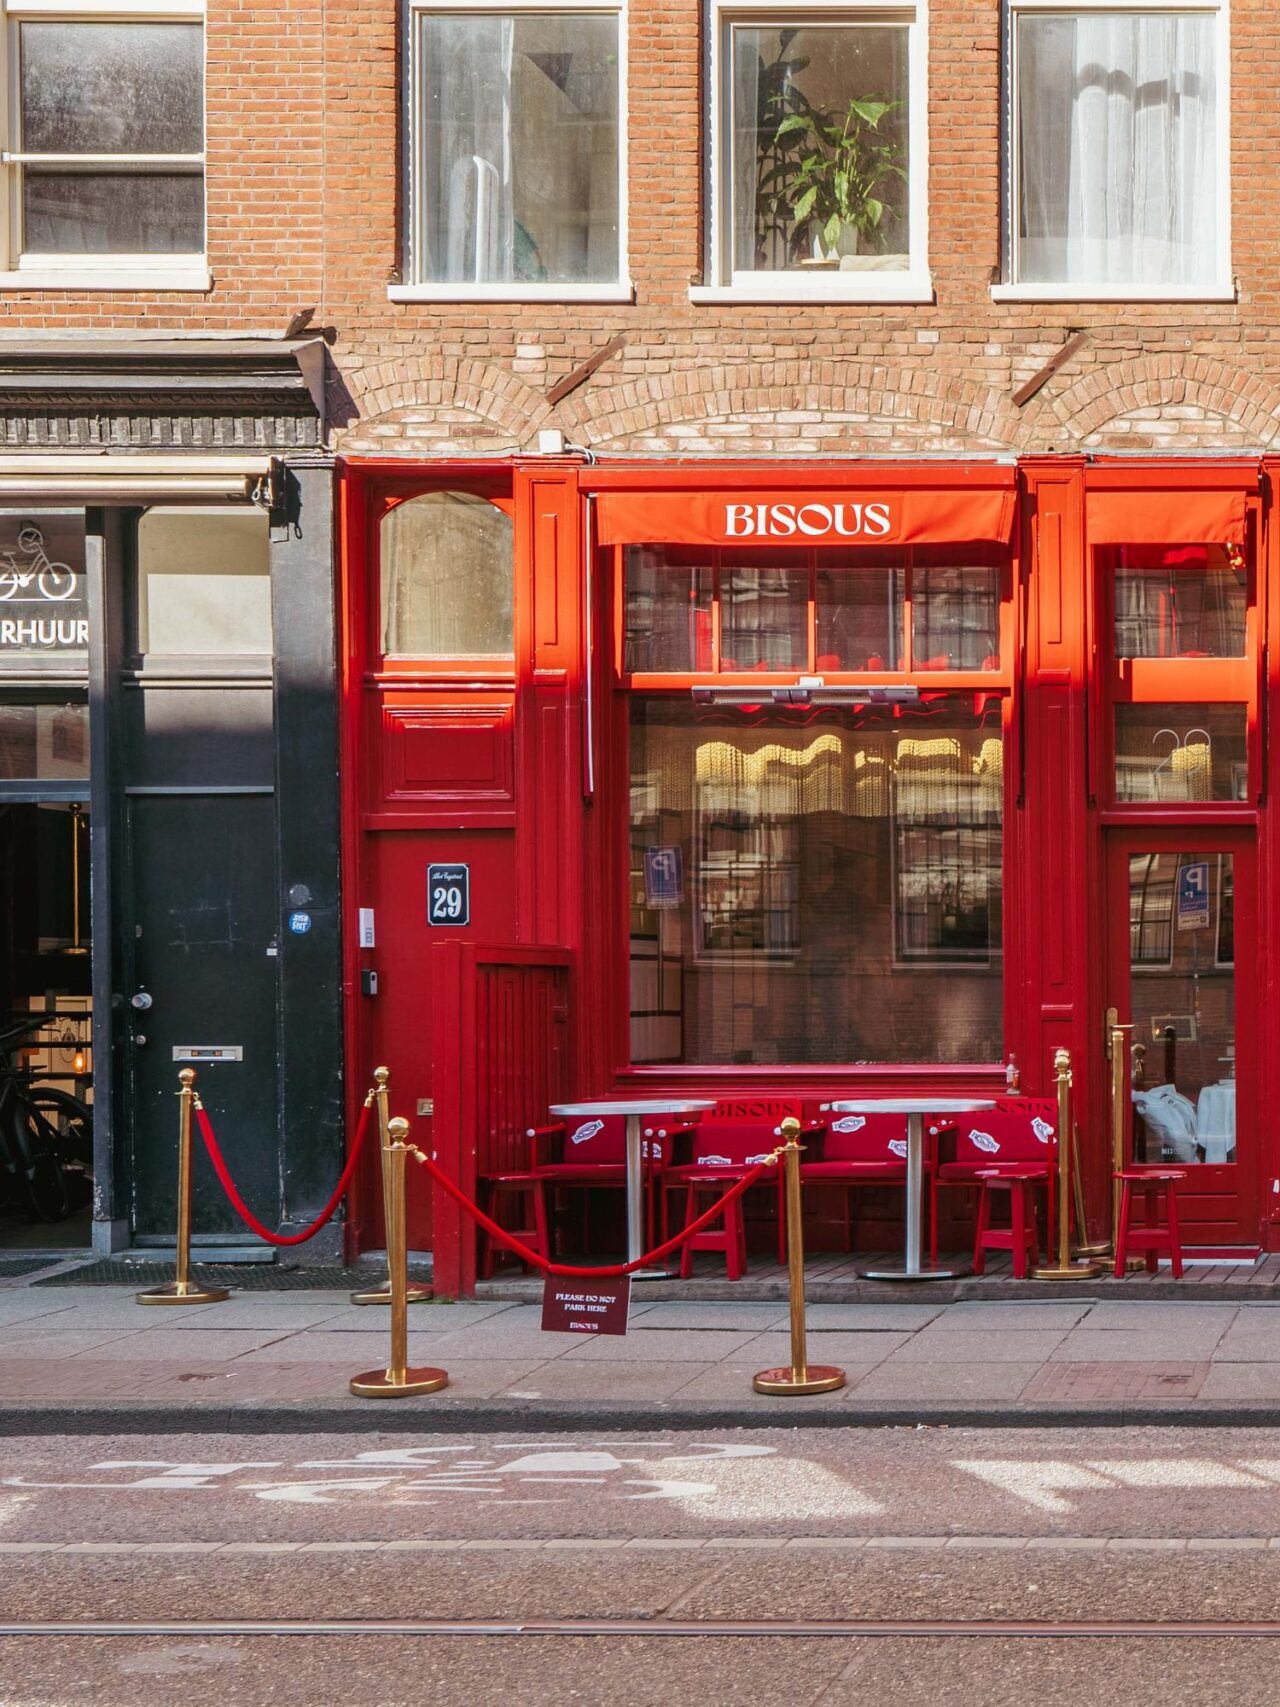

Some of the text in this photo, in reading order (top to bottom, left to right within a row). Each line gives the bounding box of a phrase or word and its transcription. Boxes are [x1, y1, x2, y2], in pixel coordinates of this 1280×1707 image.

[724, 503, 891, 536] BISOUS
[1, 619, 88, 643] RHUUR
[433, 887, 462, 917] 29
[712, 1102, 794, 1117] BISOUS
[555, 1293, 585, 1302] PLEASE
[564, 1303, 586, 1311] PARK
